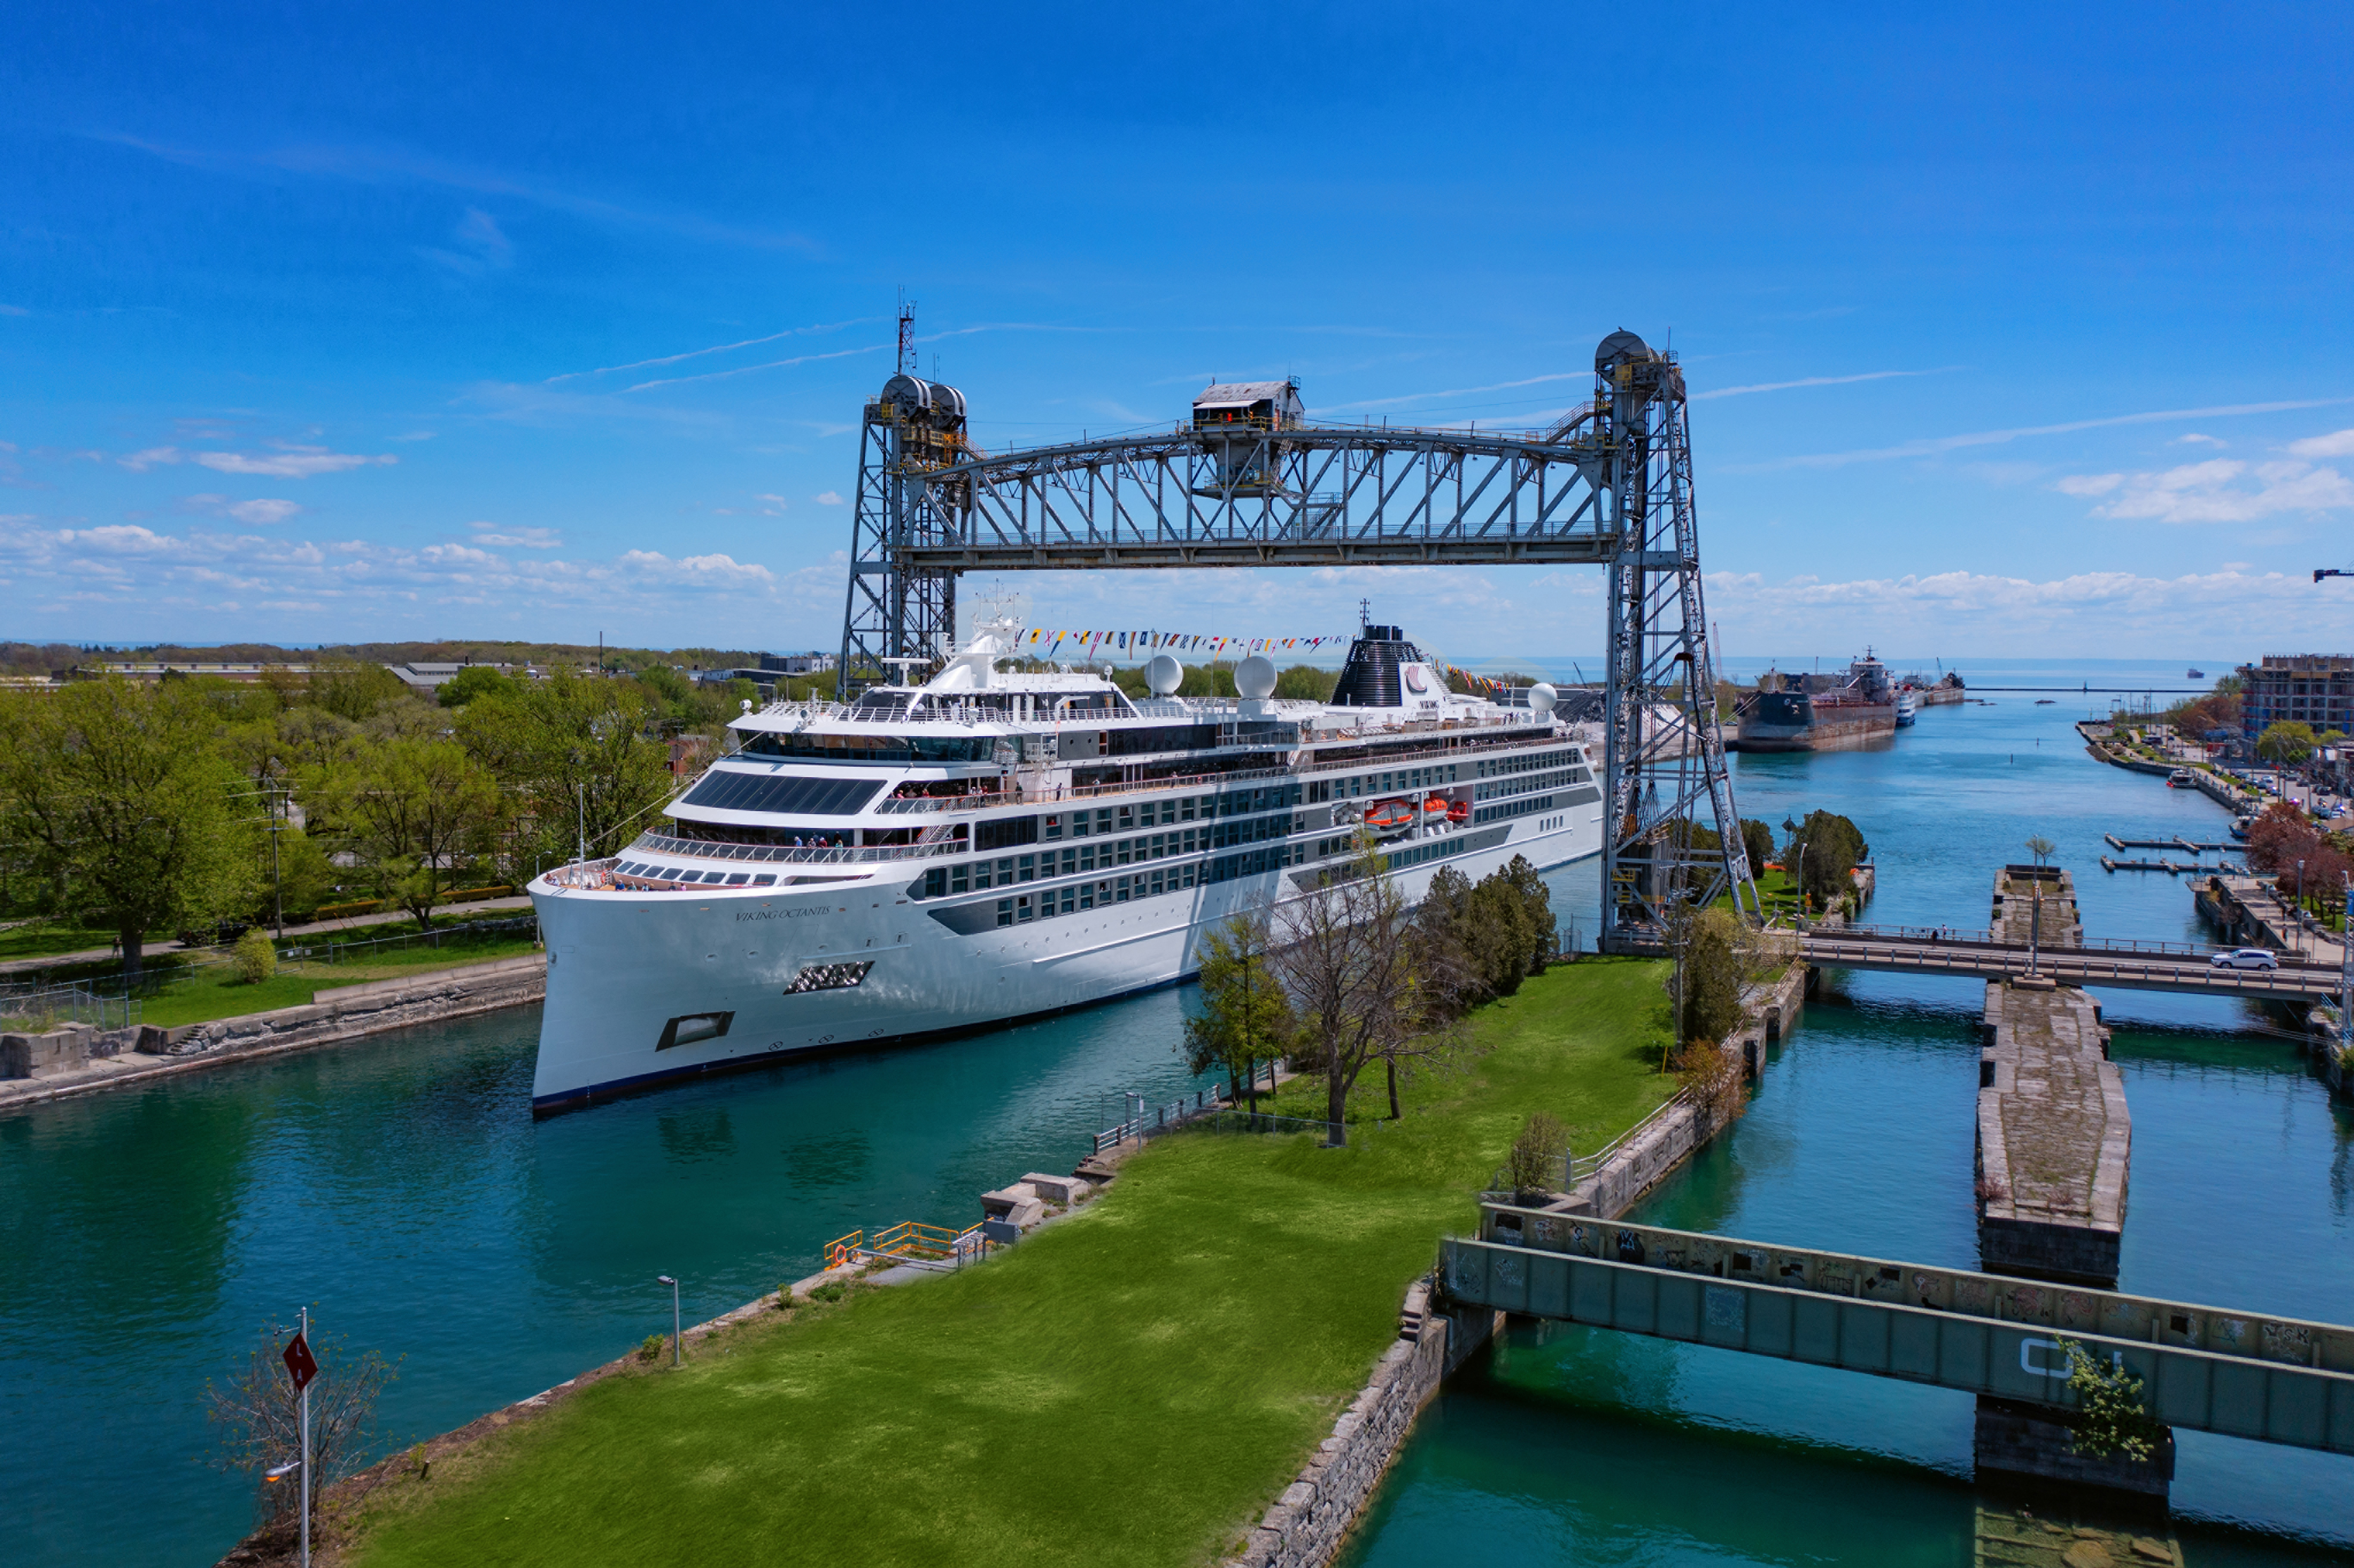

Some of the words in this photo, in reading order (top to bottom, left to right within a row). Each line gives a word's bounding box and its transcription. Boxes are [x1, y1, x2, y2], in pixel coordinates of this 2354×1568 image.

[1420, 700, 1439, 709] VIKING
[736, 910, 779, 921] VIKING
[779, 906, 831, 918] OCTANTIS
[296, 1343, 302, 1357] L
[296, 1369, 303, 1381] A
